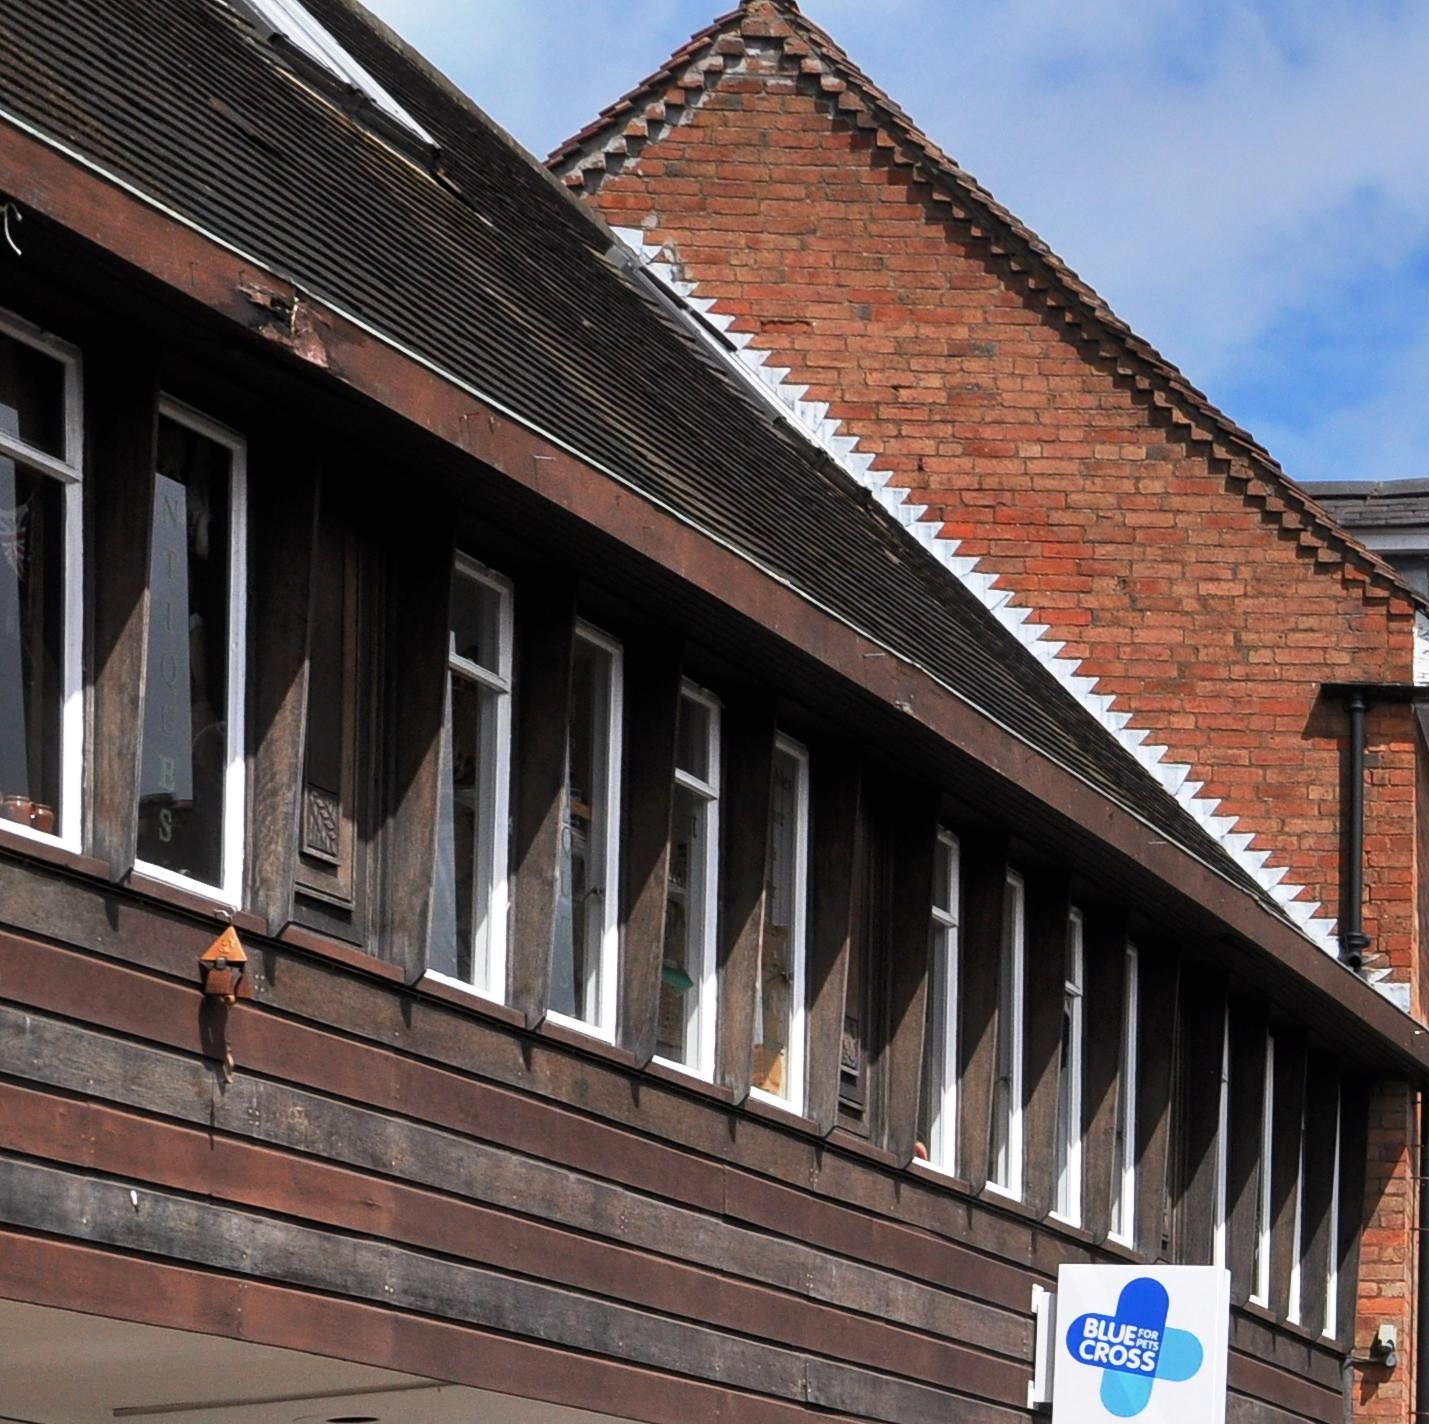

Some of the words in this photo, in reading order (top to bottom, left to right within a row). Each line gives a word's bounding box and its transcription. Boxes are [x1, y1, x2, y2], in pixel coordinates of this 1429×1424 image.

[1083, 1317, 1137, 1347] BLUE
[1137, 1328, 1160, 1340] FOR
[1135, 1338, 1160, 1351] PETS
[1079, 1339, 1156, 1372] CROSS
